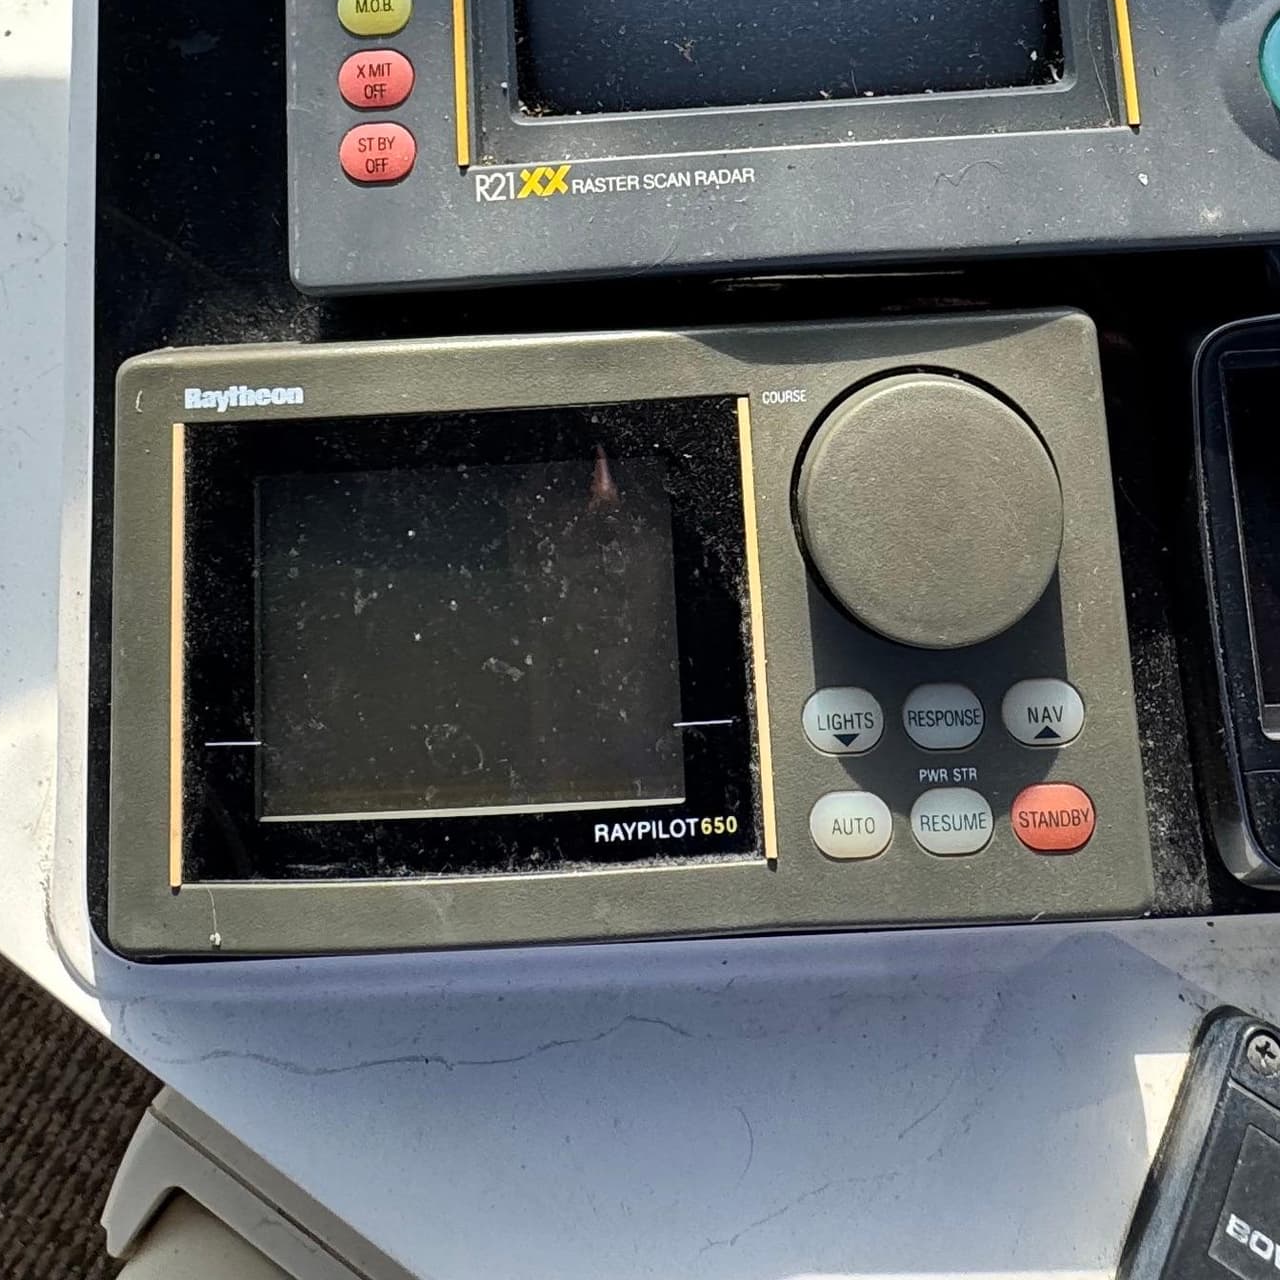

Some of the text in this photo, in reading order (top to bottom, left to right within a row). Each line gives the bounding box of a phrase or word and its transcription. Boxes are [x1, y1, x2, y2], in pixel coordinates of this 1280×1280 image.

[364, 84, 387, 99] OFF
[365, 158, 389, 173] OFF
[572, 173, 640, 194] RASTER
[643, 170, 692, 190] SCAN
[694, 167, 756, 187] RADAR
[184, 385, 304, 412] Raytheon
[762, 389, 807, 404] COURSE
[817, 711, 874, 731] LIGHTS
[907, 708, 981, 729] RESPONSE
[1027, 705, 1064, 724] NAV
[919, 767, 978, 783] PWR STR
[832, 817, 875, 835] AUTO
[920, 812, 988, 832] RESUME
[1019, 807, 1091, 829] STANDBY
